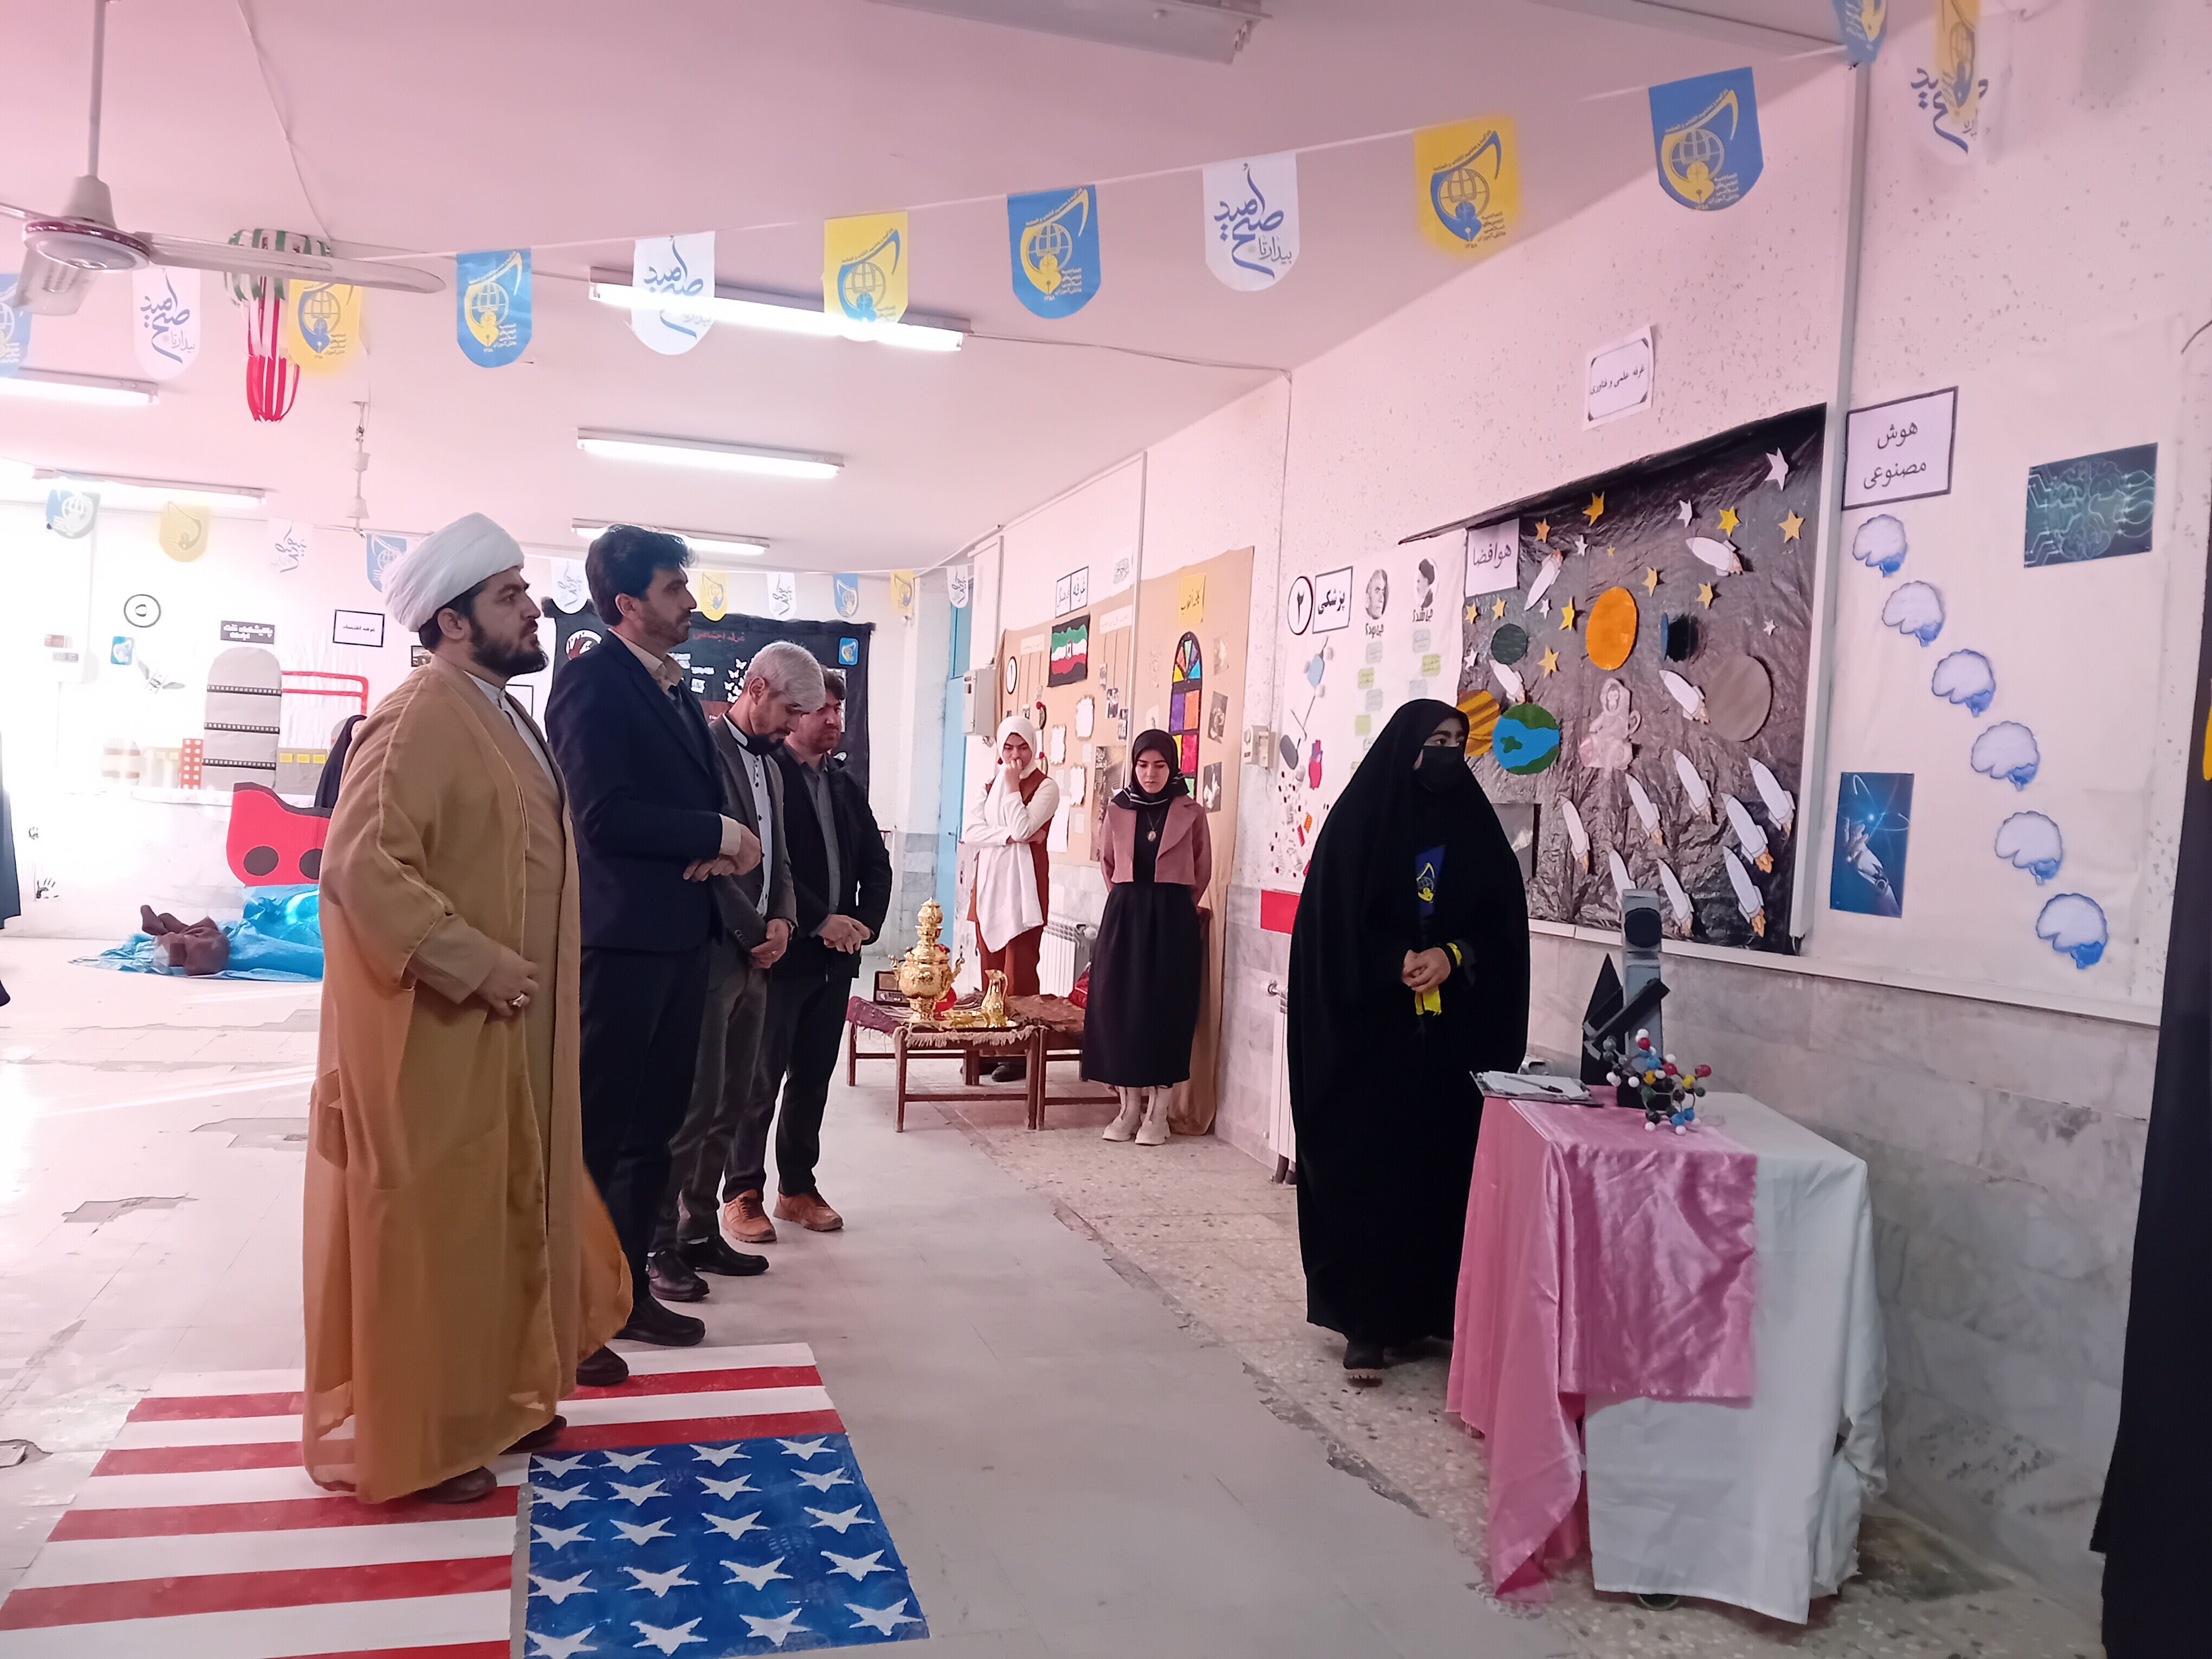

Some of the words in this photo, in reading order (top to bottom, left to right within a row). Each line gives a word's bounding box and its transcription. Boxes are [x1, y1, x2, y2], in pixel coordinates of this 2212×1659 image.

[1264, 236, 1292, 265] بیدار
[1613, 371, 1630, 388] علمی
[1877, 422, 1918, 449] هوش
[1863, 462, 1927, 490] مصنوعی
[1318, 588, 1345, 615] پزشکی
